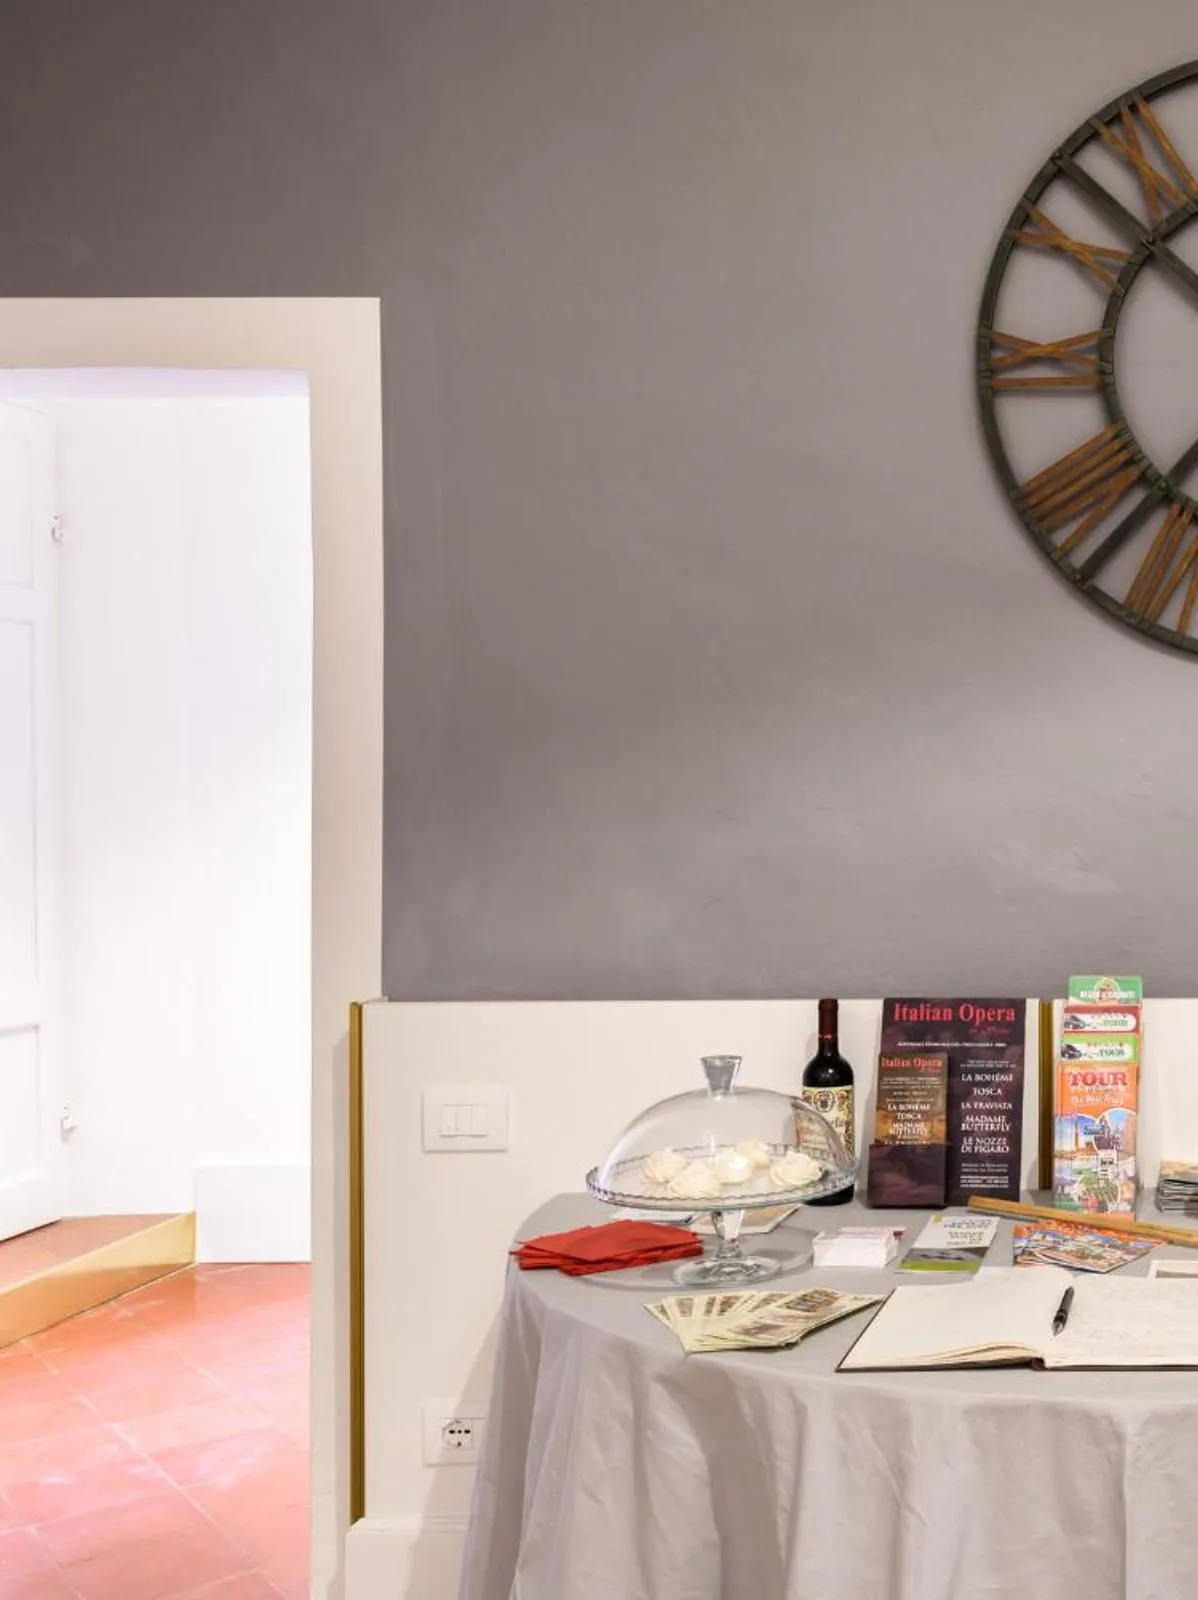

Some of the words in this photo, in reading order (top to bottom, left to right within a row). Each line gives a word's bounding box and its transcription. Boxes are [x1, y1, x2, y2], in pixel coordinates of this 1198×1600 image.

[1010, 202, 1132, 290] X
[988, 328, 1102, 391] IX
[1015, 422, 1141, 556] VIII
[893, 1003, 954, 1022] Italian
[959, 1003, 1016, 1026] Opera
[881, 1057, 912, 1068] Italian
[913, 1057, 943, 1072] Opera
[961, 1074, 973, 1082] LA
[1069, 1072, 1128, 1087] TOUR
[973, 1088, 1003, 1096] TOSCA
[974, 1102, 1013, 1110] TRAVIATA
[965, 1115, 1007, 1123] MADAME
[961, 1123, 1012, 1132] BUTTERFLY
[962, 1137, 974, 1145] LE
[975, 1137, 1007, 1146] NOZZE
[974, 1145, 1010, 1154] FIGARO
